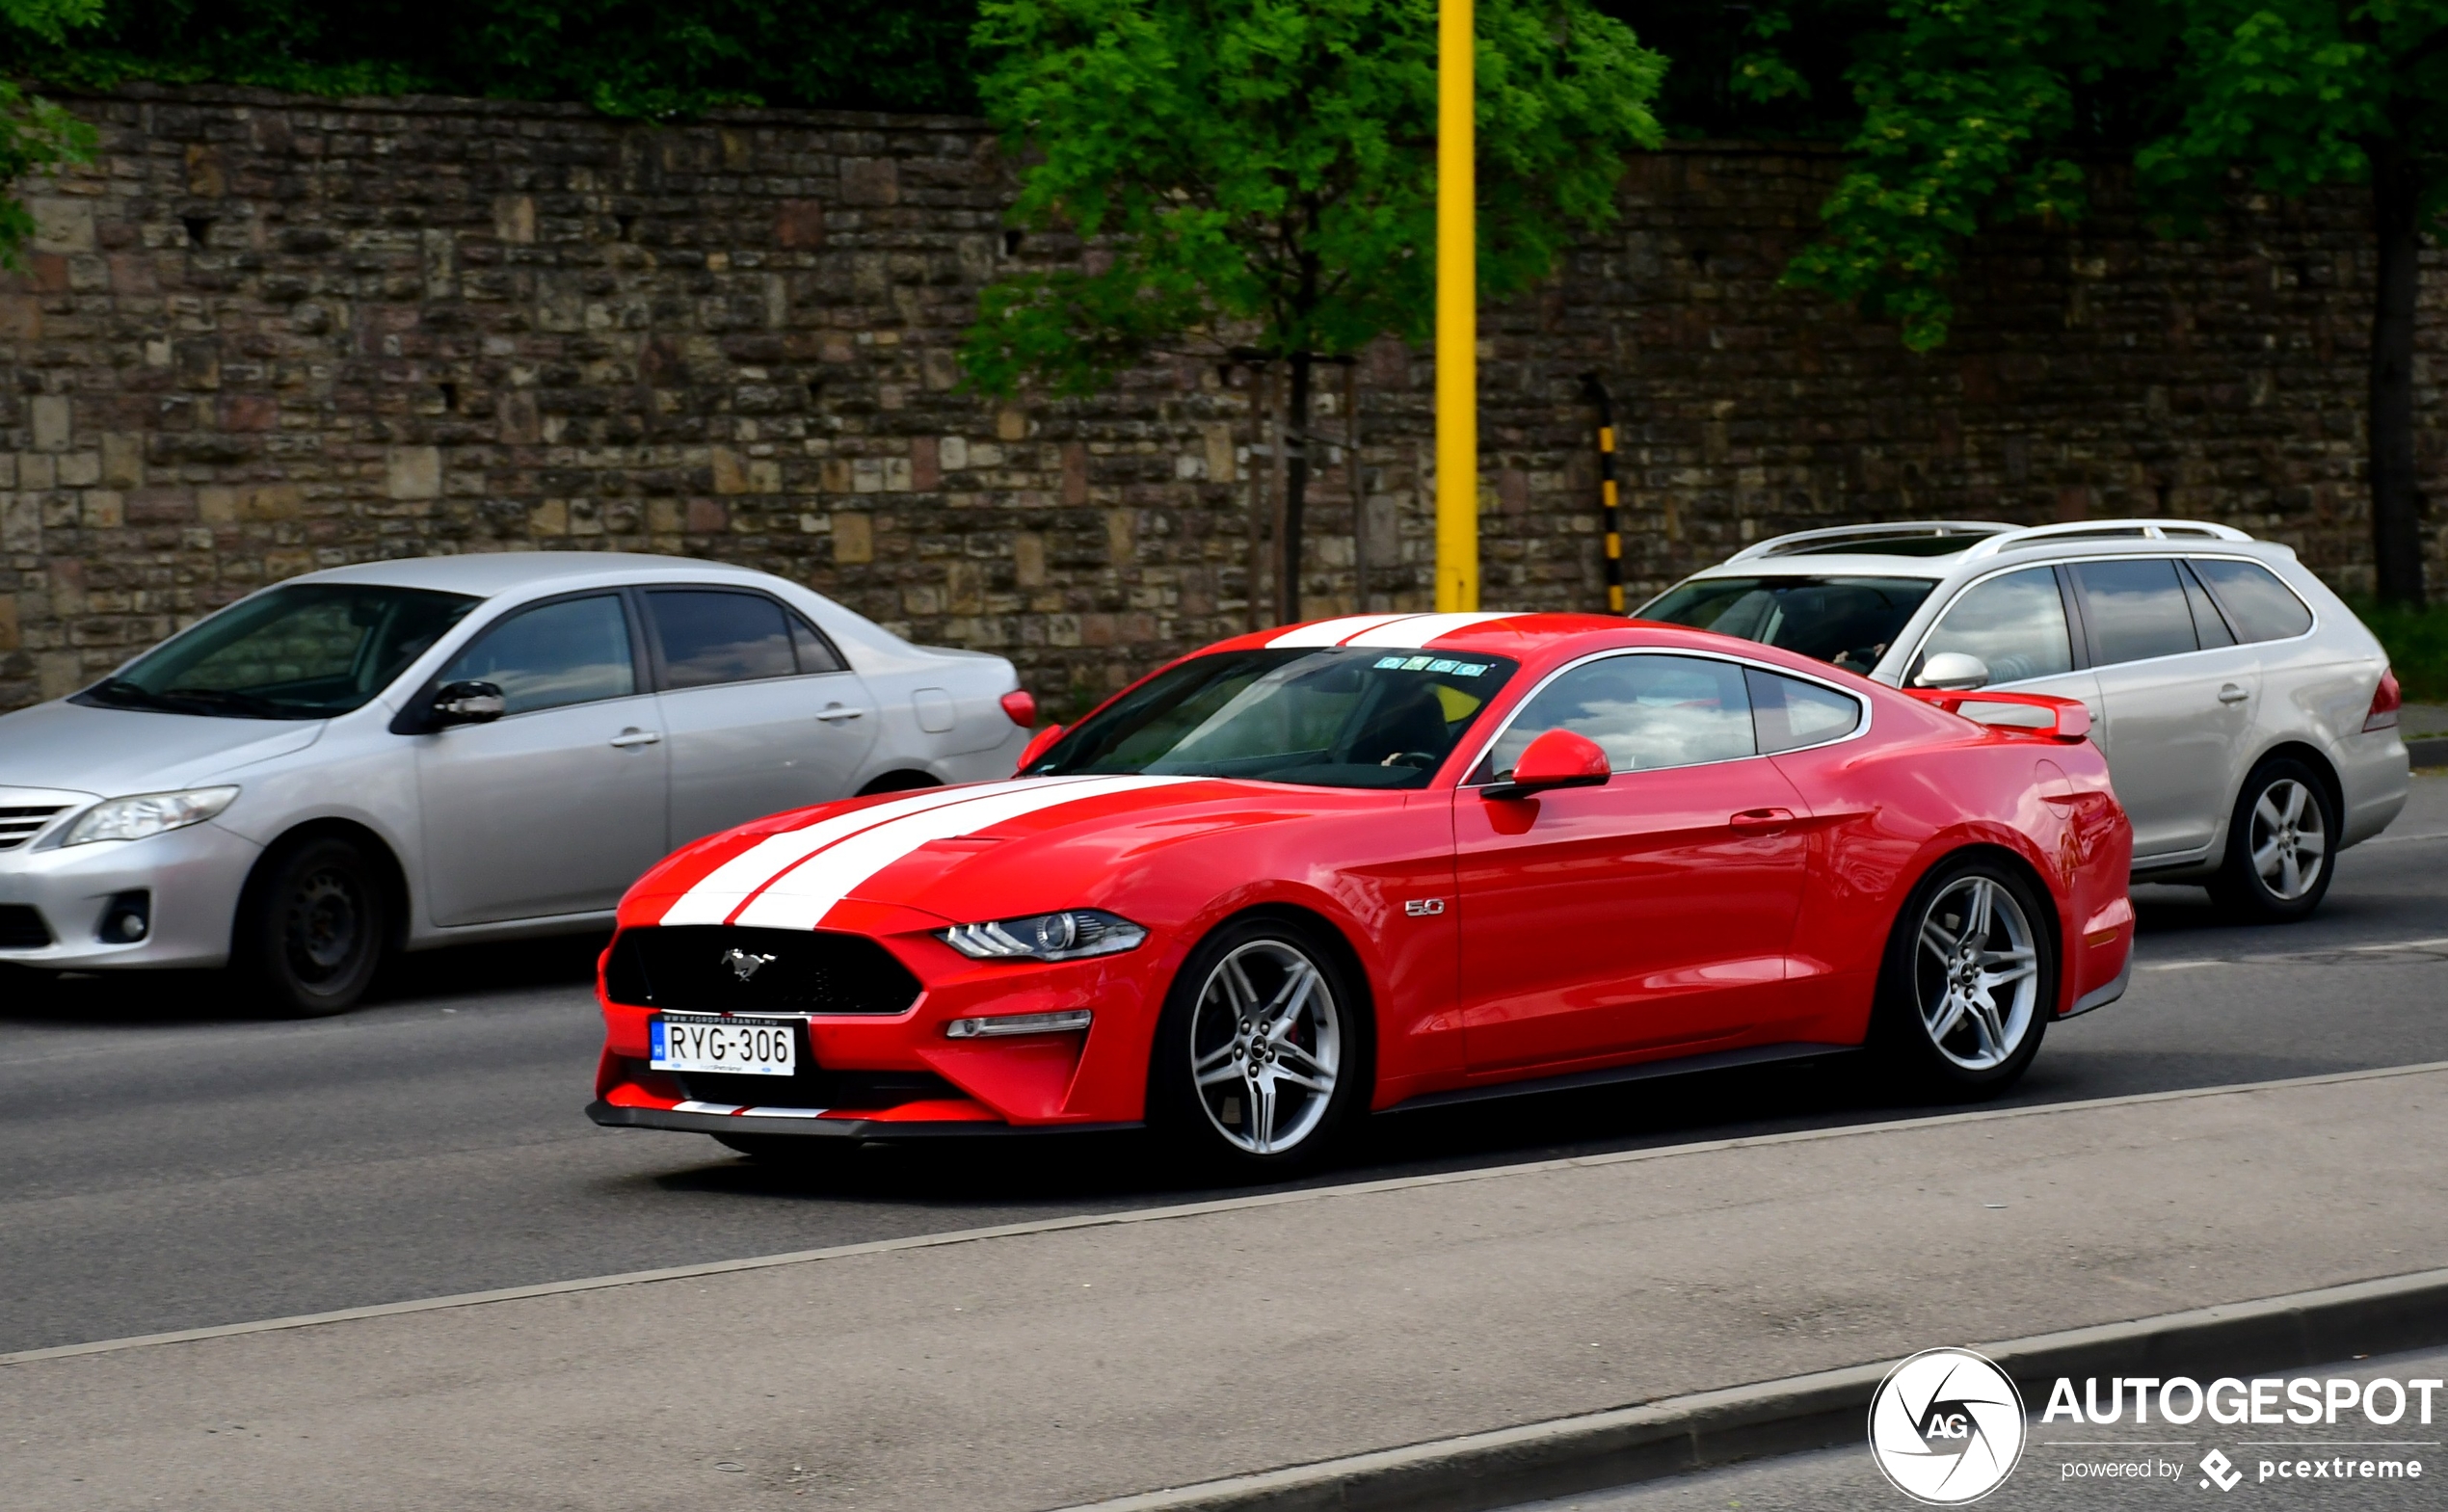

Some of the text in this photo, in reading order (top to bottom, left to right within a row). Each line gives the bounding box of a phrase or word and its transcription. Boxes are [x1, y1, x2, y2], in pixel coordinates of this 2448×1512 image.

[1405, 898, 1445, 916] 5.0
[654, 1044, 663, 1056] H
[671, 1026, 787, 1063] RYG-306
